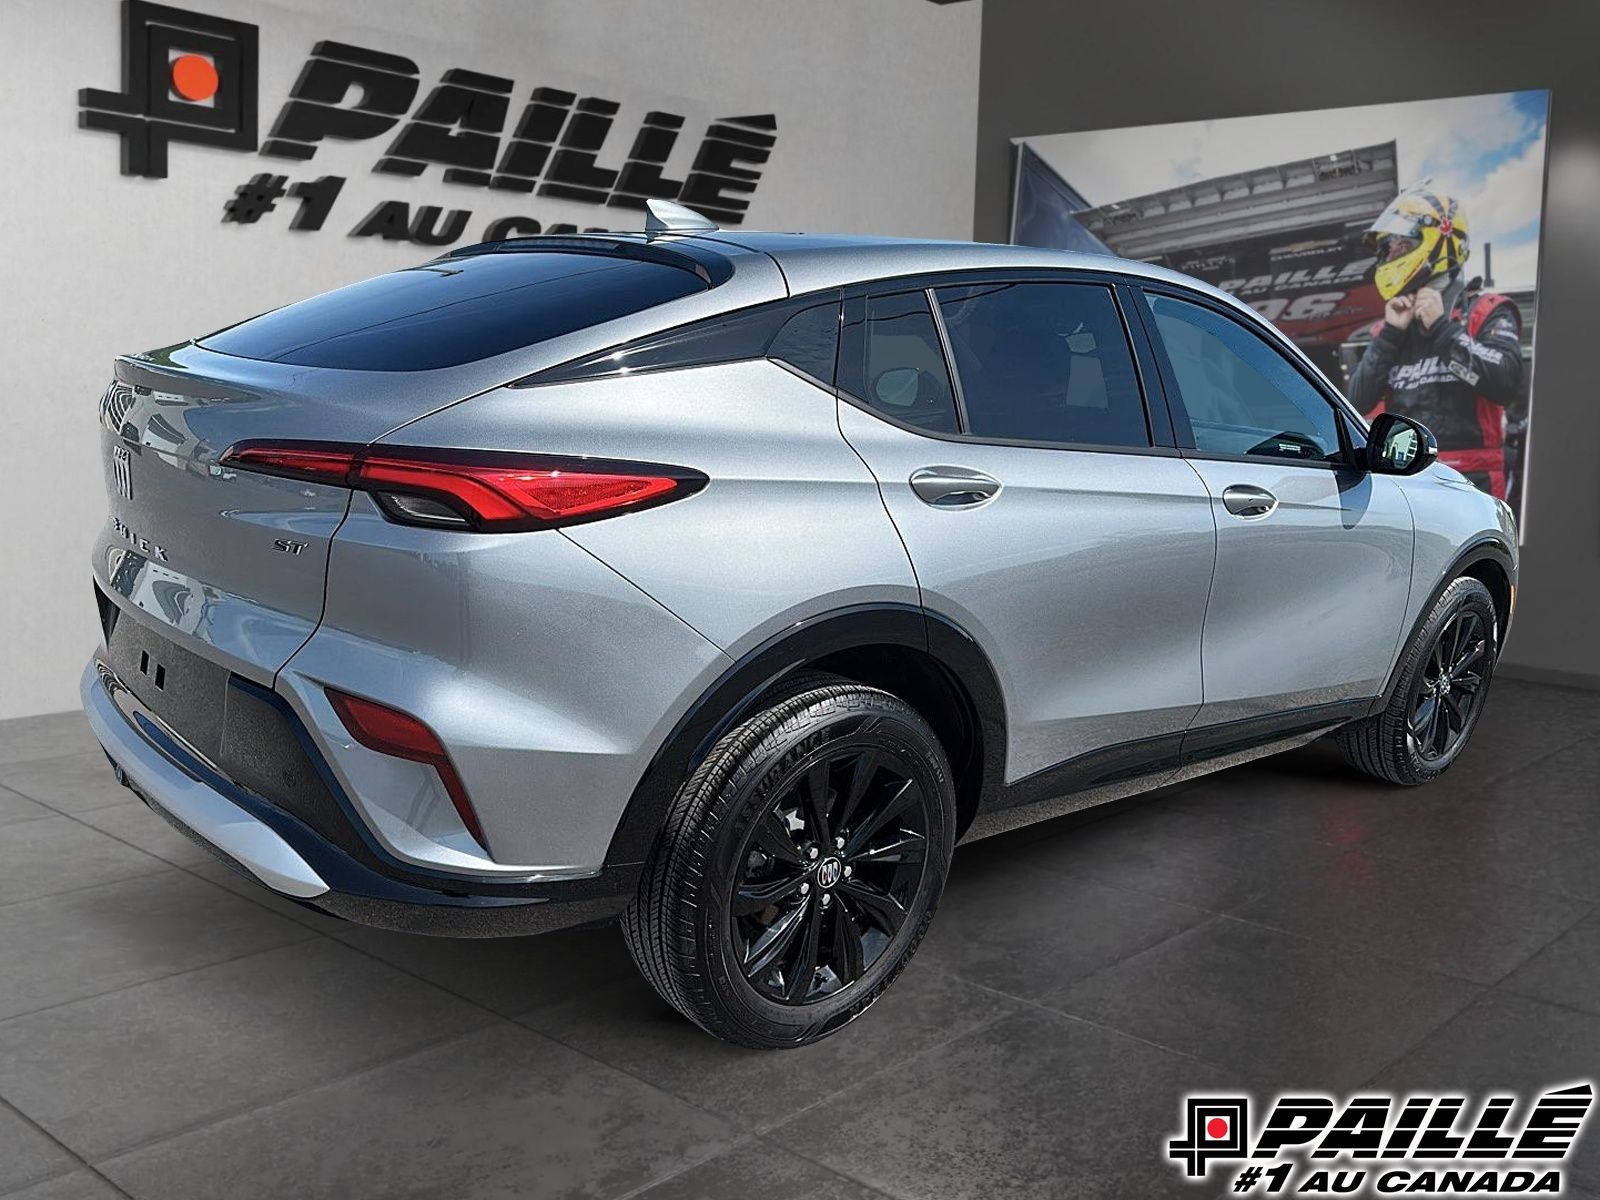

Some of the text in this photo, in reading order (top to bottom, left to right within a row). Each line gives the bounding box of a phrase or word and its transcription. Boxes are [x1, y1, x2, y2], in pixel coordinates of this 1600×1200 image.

[259, 40, 777, 224] PAILLÉ
[220, 173, 346, 231] #1
[346, 200, 473, 247] AU
[272, 538, 308, 556] ST
